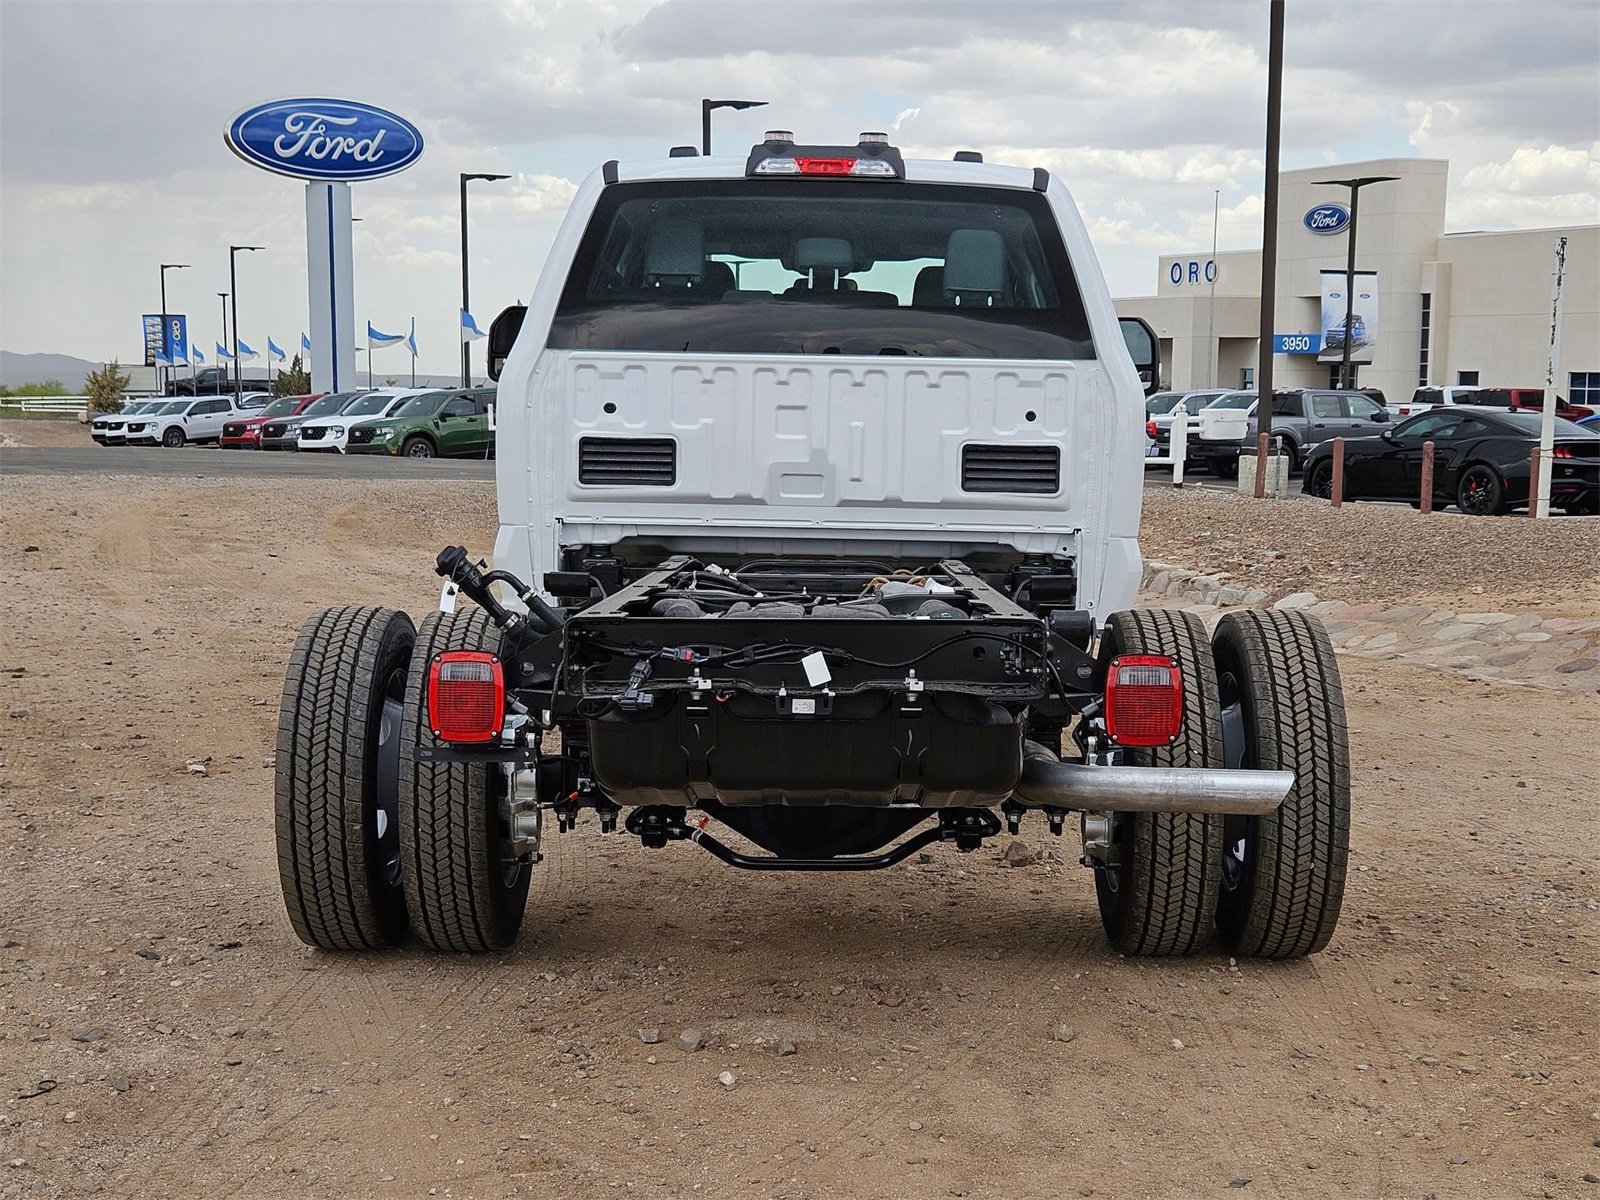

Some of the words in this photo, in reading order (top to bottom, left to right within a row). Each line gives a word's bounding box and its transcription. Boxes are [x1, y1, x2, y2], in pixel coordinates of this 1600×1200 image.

[273, 112, 386, 163] Ford
[1311, 209, 1339, 229] Ford
[1170, 259, 1218, 285] ORO
[1282, 337, 1310, 351] 3950
